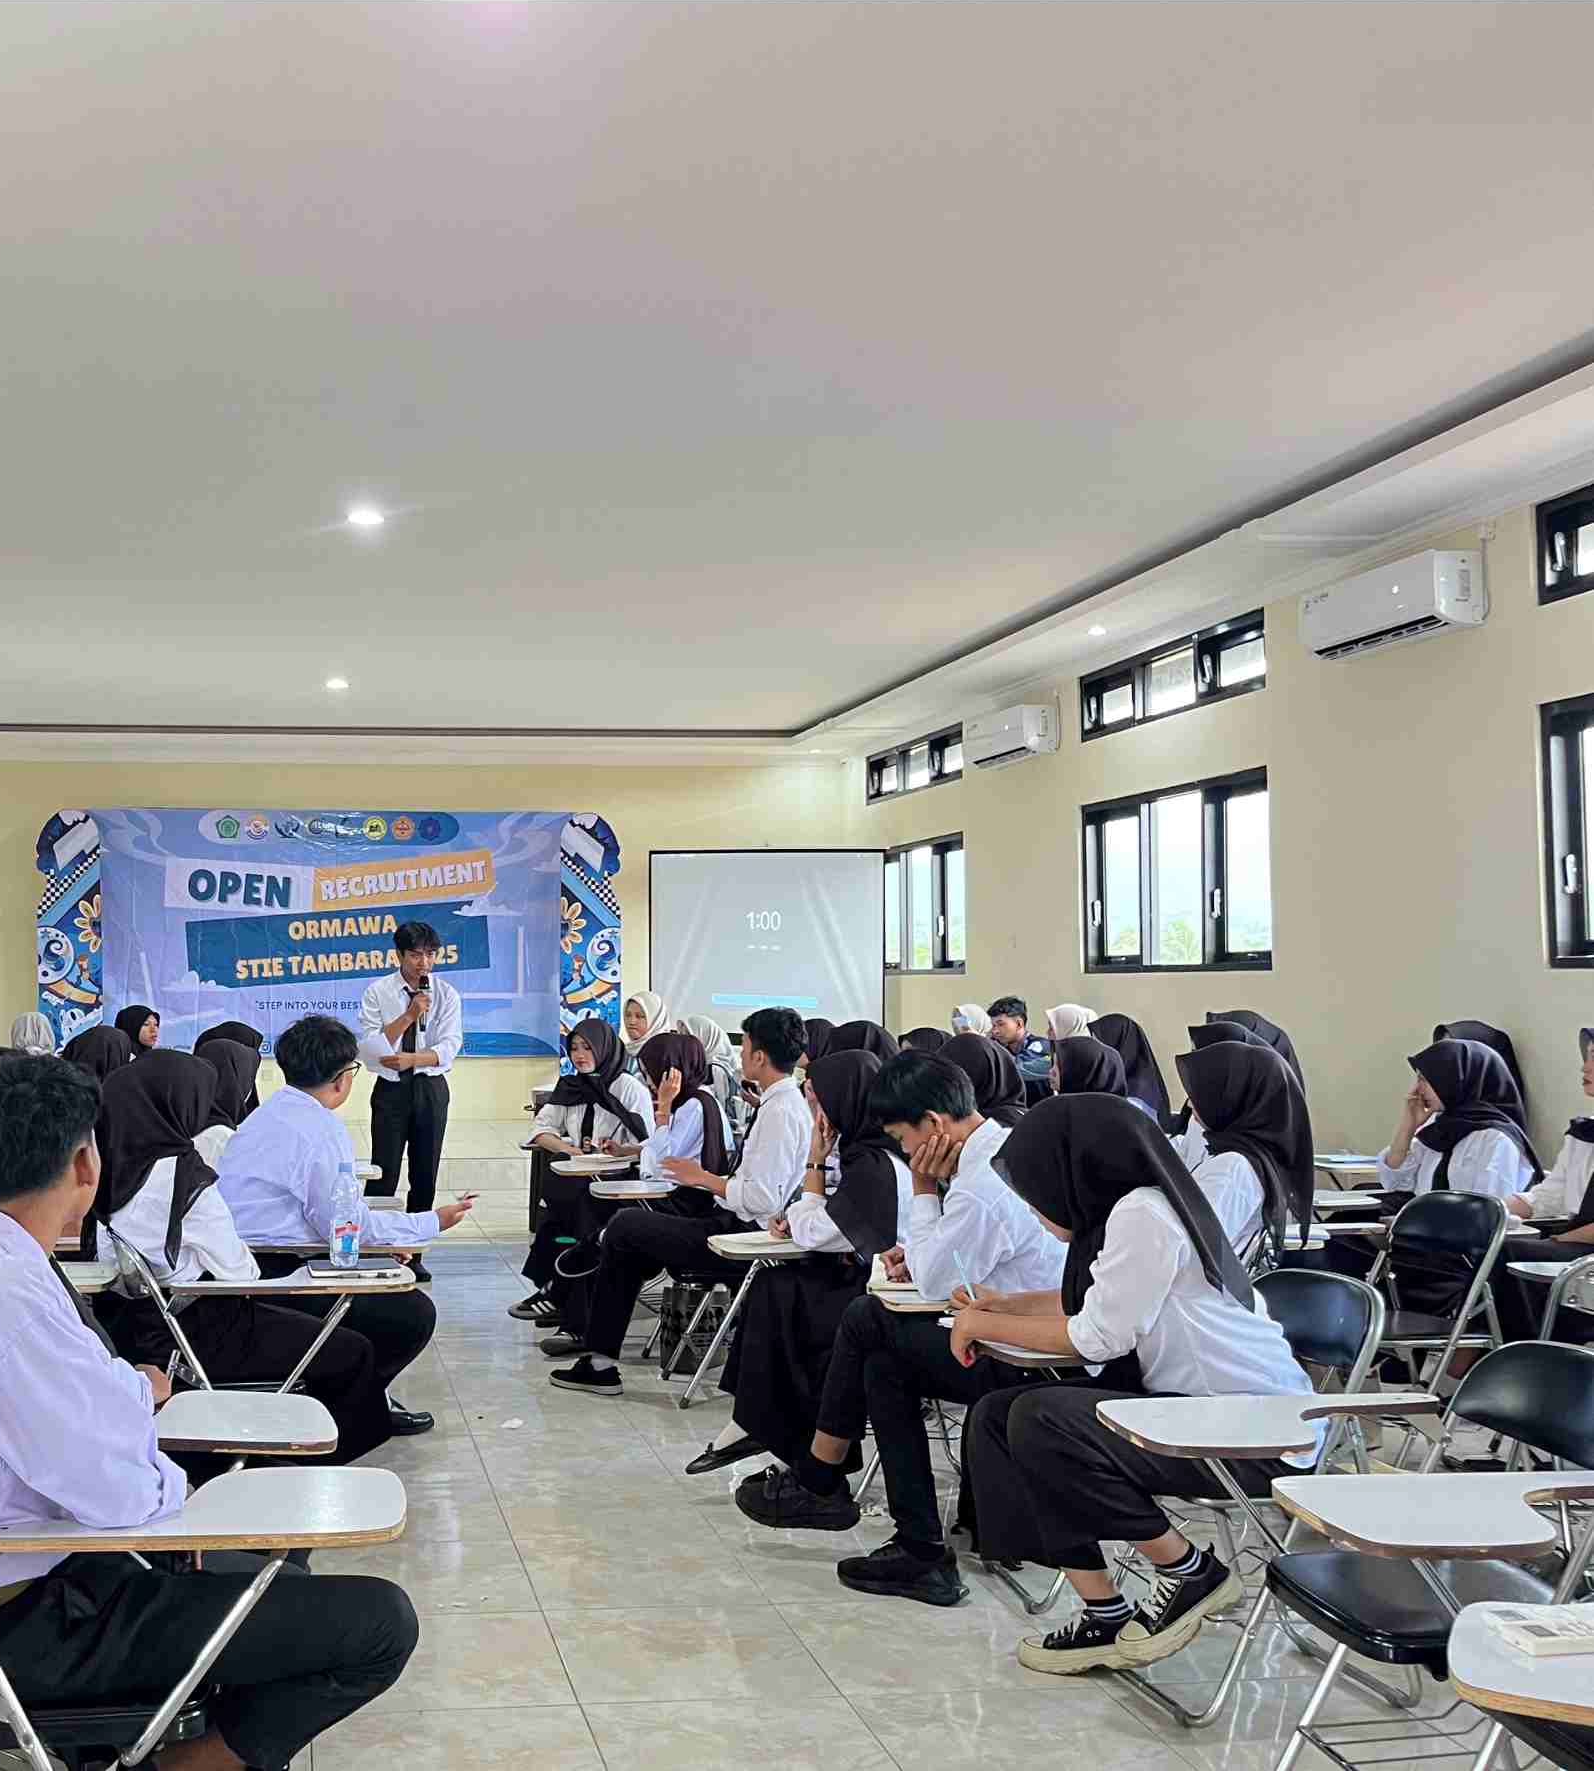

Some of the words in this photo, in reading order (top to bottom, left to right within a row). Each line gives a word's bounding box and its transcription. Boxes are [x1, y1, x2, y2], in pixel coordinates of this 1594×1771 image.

[187, 869, 292, 908] OPEN
[320, 860, 486, 901] RECRUITMENT
[288, 914, 398, 941] ORMAWA
[235, 957, 284, 980] STIE
[287, 948, 400, 975] TAMBARA
[434, 944, 458, 965] 25
[284, 1001, 308, 1010] INTO
[309, 1001, 338, 1010] YOUR
